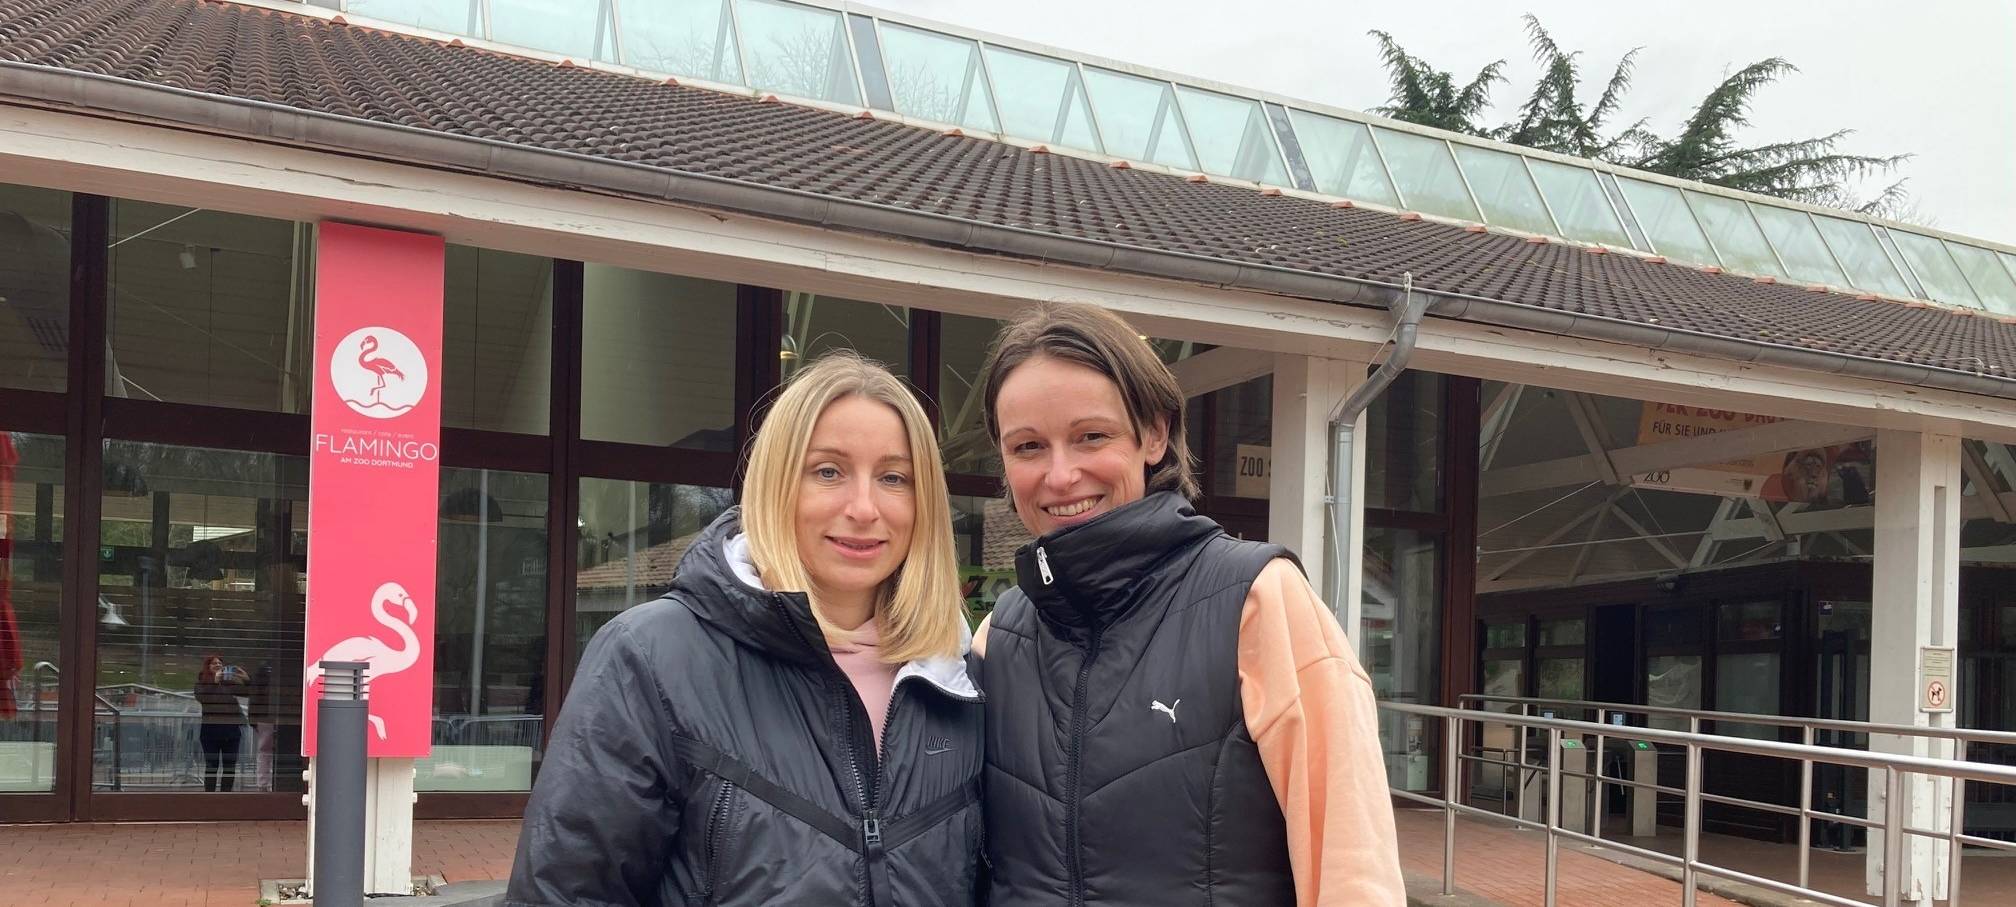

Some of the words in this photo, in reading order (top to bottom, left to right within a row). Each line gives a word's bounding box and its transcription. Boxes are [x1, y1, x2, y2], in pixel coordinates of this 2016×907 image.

[1653, 418, 1672, 434] FÜR
[1674, 423, 1690, 436] SIE
[315, 433, 438, 460] FLAMINGO
[340, 456, 352, 464] AM
[353, 457, 370, 466] ZOO
[371, 458, 414, 469] DORTMUND
[1240, 455, 1264, 477] ZOO
